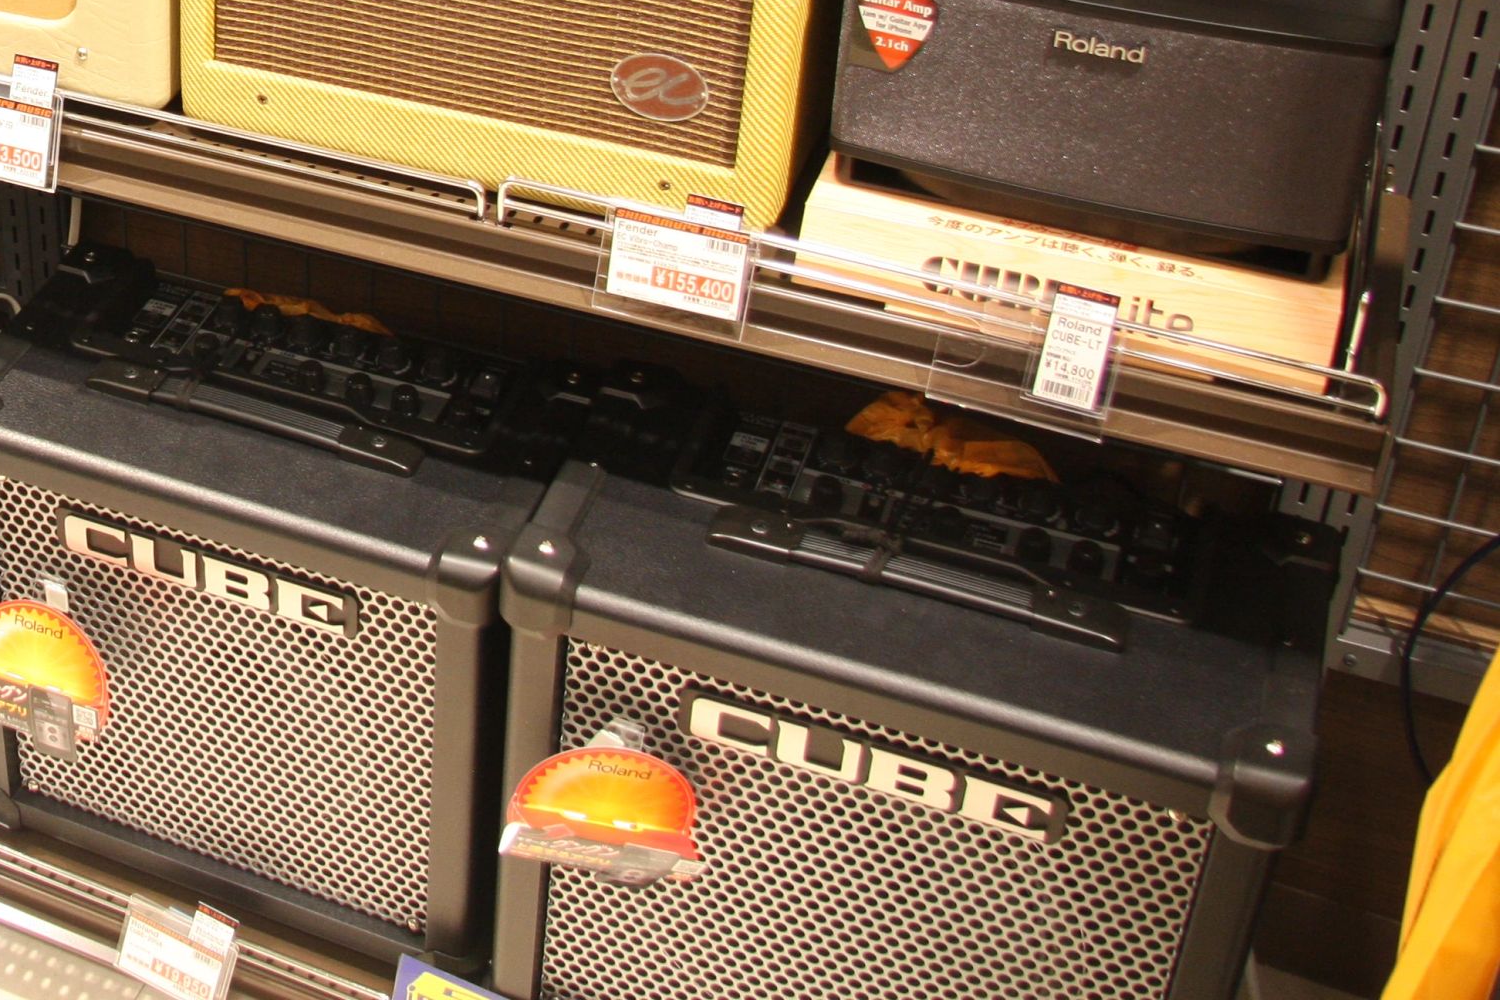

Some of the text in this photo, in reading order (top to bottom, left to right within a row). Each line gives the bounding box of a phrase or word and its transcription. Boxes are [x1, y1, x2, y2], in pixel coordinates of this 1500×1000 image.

[903, 0, 933, 18] Amp
[875, 36, 909, 52] 2.1ch
[1053, 30, 1146, 64] Roland
[14, 82, 48, 97] Fender
[617, 220, 659, 238] Fender
[654, 269, 734, 301] ¥155,400
[1056, 316, 1103, 337] Roland
[1051, 329, 1103, 351] CUBE-LT
[1044, 358, 1095, 380] ¥14,800
[64, 514, 349, 636] CUBE
[14, 614, 64, 640] Roland
[587, 760, 653, 780] Roland
[689, 696, 1056, 844] CUBE
